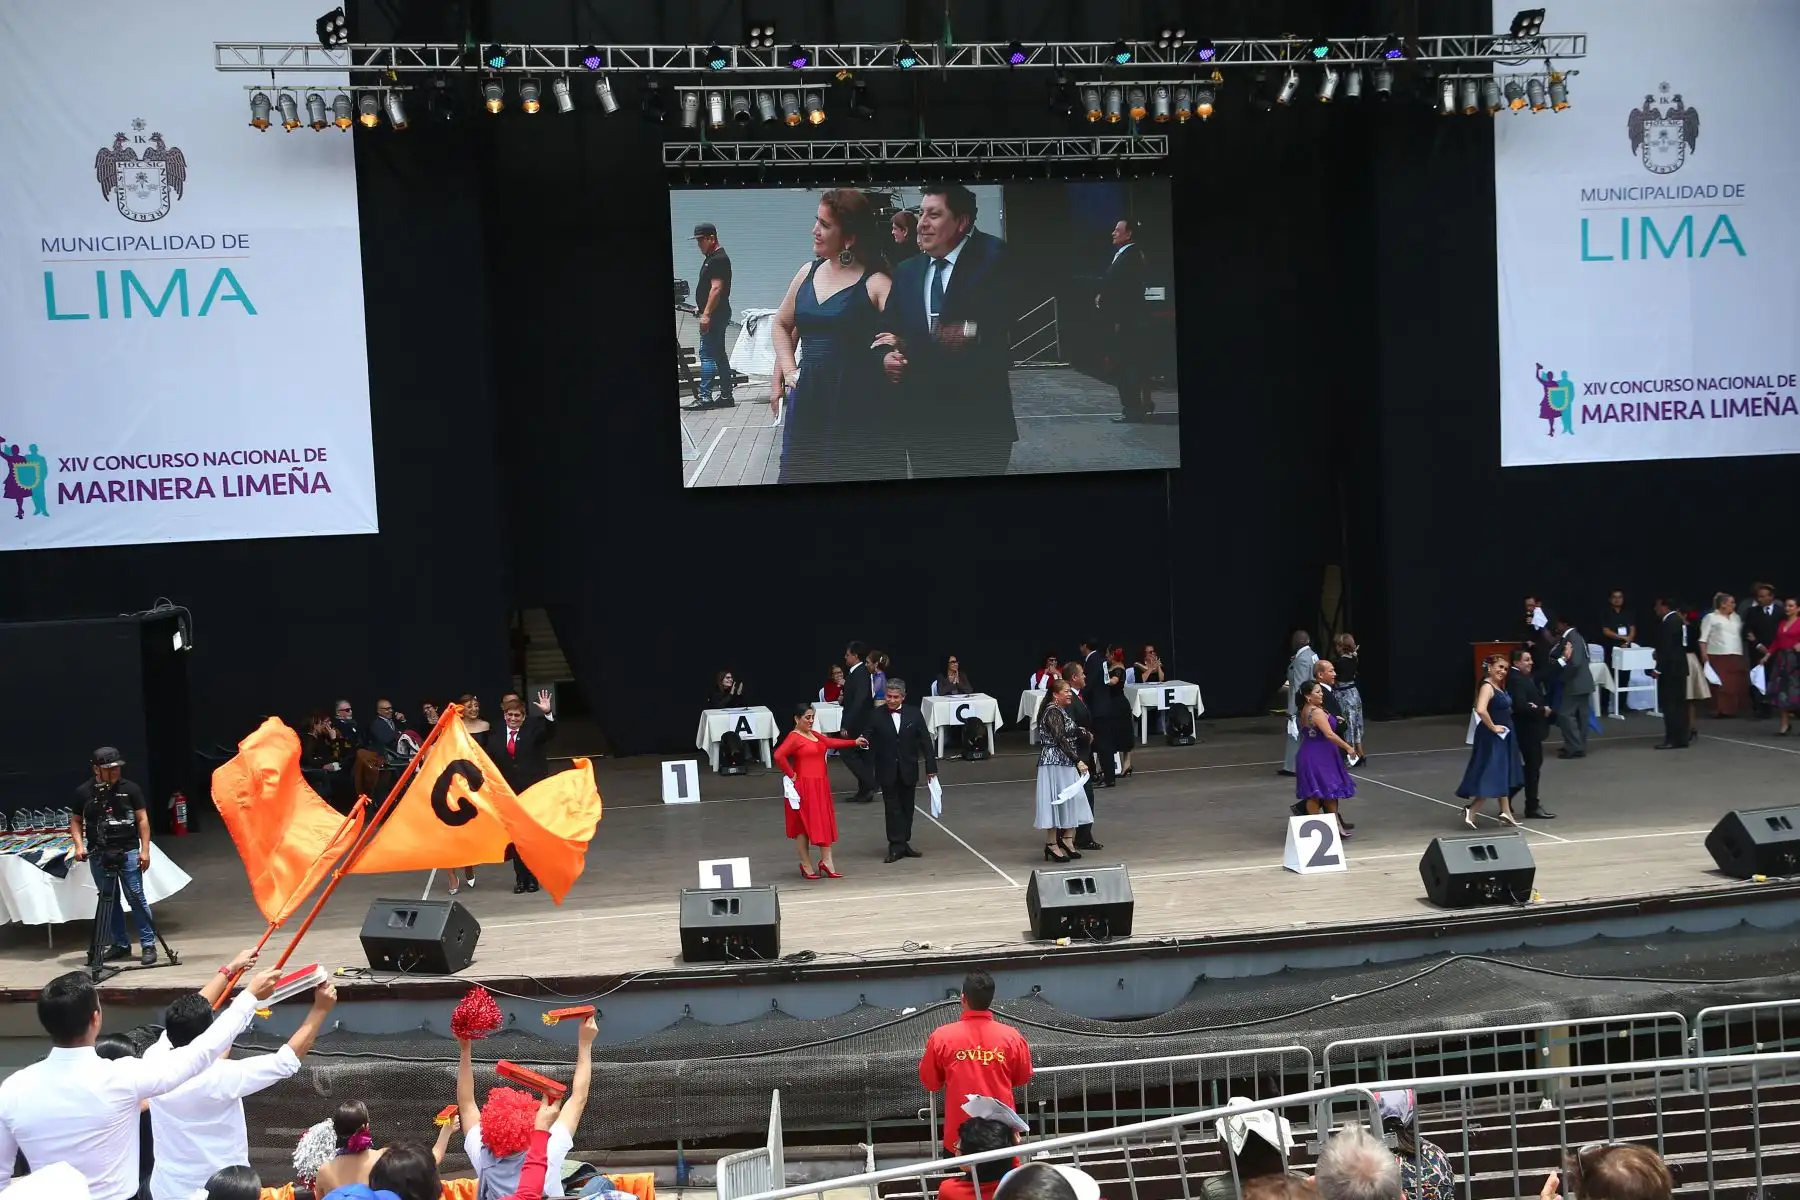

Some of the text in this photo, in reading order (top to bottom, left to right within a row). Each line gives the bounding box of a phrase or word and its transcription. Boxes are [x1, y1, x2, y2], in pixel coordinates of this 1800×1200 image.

[134, 135, 146, 144] IK
[1582, 184, 1746, 202] MUNICIPALIDAD DE
[42, 234, 250, 253] MUNICIPALIDAD DE
[1581, 214, 1747, 262] LIMA
[44, 268, 258, 321] LIMA
[1584, 374, 1798, 396] XIV CONCURSO NACIONAL DE
[1582, 391, 1799, 425] MARINERA LIMEÑA
[58, 447, 328, 473] XIV CONCURSO NACIONAL DE
[57, 466, 332, 505] MARINERA LIMEÑA
[1164, 689, 1175, 708] E
[735, 715, 754, 735] A
[956, 704, 970, 724] C
[671, 764, 688, 798] 1
[1299, 820, 1340, 867] 2
